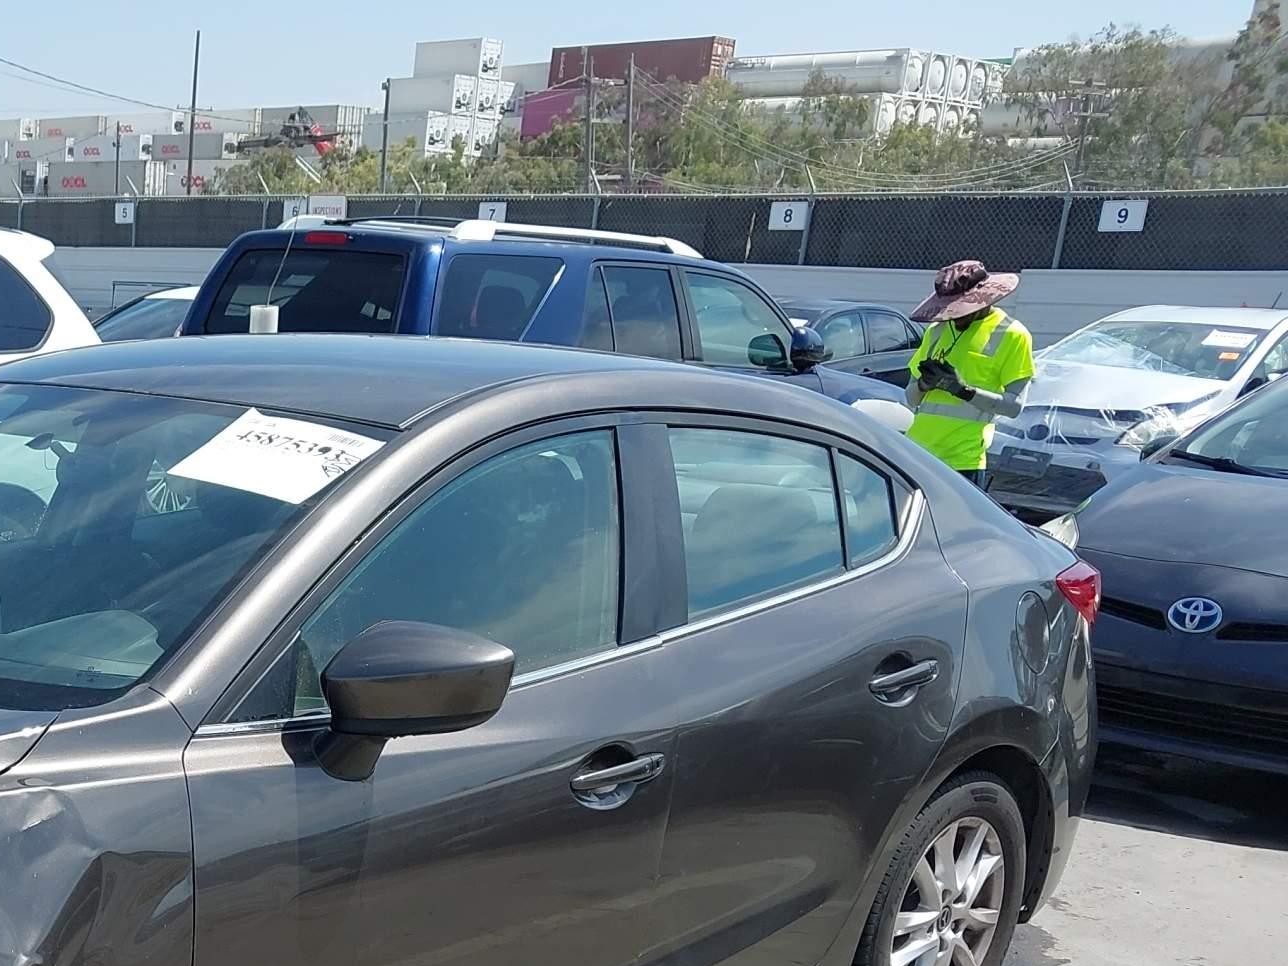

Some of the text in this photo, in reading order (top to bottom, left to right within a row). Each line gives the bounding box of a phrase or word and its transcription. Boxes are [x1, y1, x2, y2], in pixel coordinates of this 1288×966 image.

[15, 150, 31, 159] OOCL
[83, 146, 100, 156] OOCL
[161, 144, 180, 154] OOCL
[62, 177, 87, 188] OOCL
[122, 207, 128, 218] 5
[292, 206, 299, 217] 6
[489, 208, 496, 220] 7
[783, 208, 793, 223] 8
[1116, 207, 1130, 224] 9
[236, 430, 346, 460] 45875393
